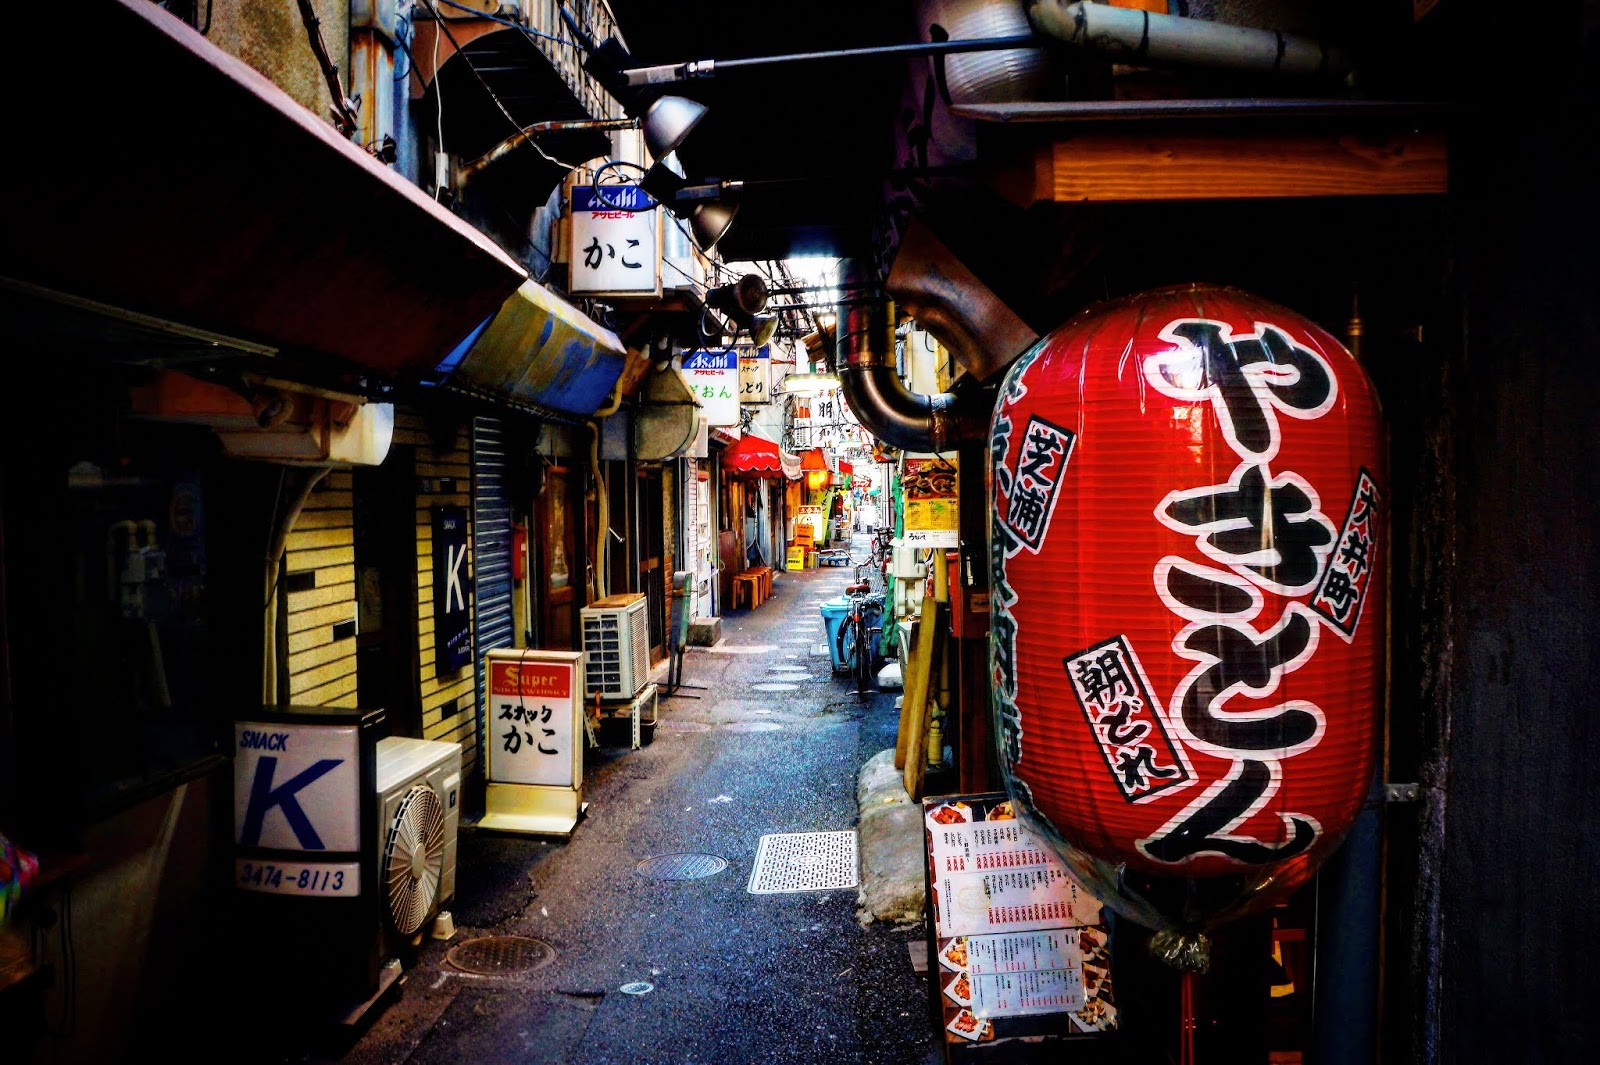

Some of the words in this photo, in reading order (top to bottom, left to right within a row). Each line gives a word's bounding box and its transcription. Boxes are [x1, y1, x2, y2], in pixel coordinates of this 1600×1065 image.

[587, 188, 637, 208] Asahi
[592, 211, 635, 219] アサヒビール
[583, 236, 642, 270] かこ
[690, 353, 728, 368] Asahi
[1323, 485, 1378, 620] 大井町
[446, 543, 467, 614] K
[1137, 319, 1337, 865] やきとん
[502, 665, 557, 688] Super
[494, 686, 526, 694] NIKKA
[527, 688, 568, 696] WHISKY
[498, 704, 552, 723] スナック
[1075, 649, 1177, 788] 朝どれ
[240, 730, 289, 751] SNACK
[502, 725, 558, 755] かこ
[240, 756, 345, 850] K
[241, 864, 345, 891] 3474-8113
